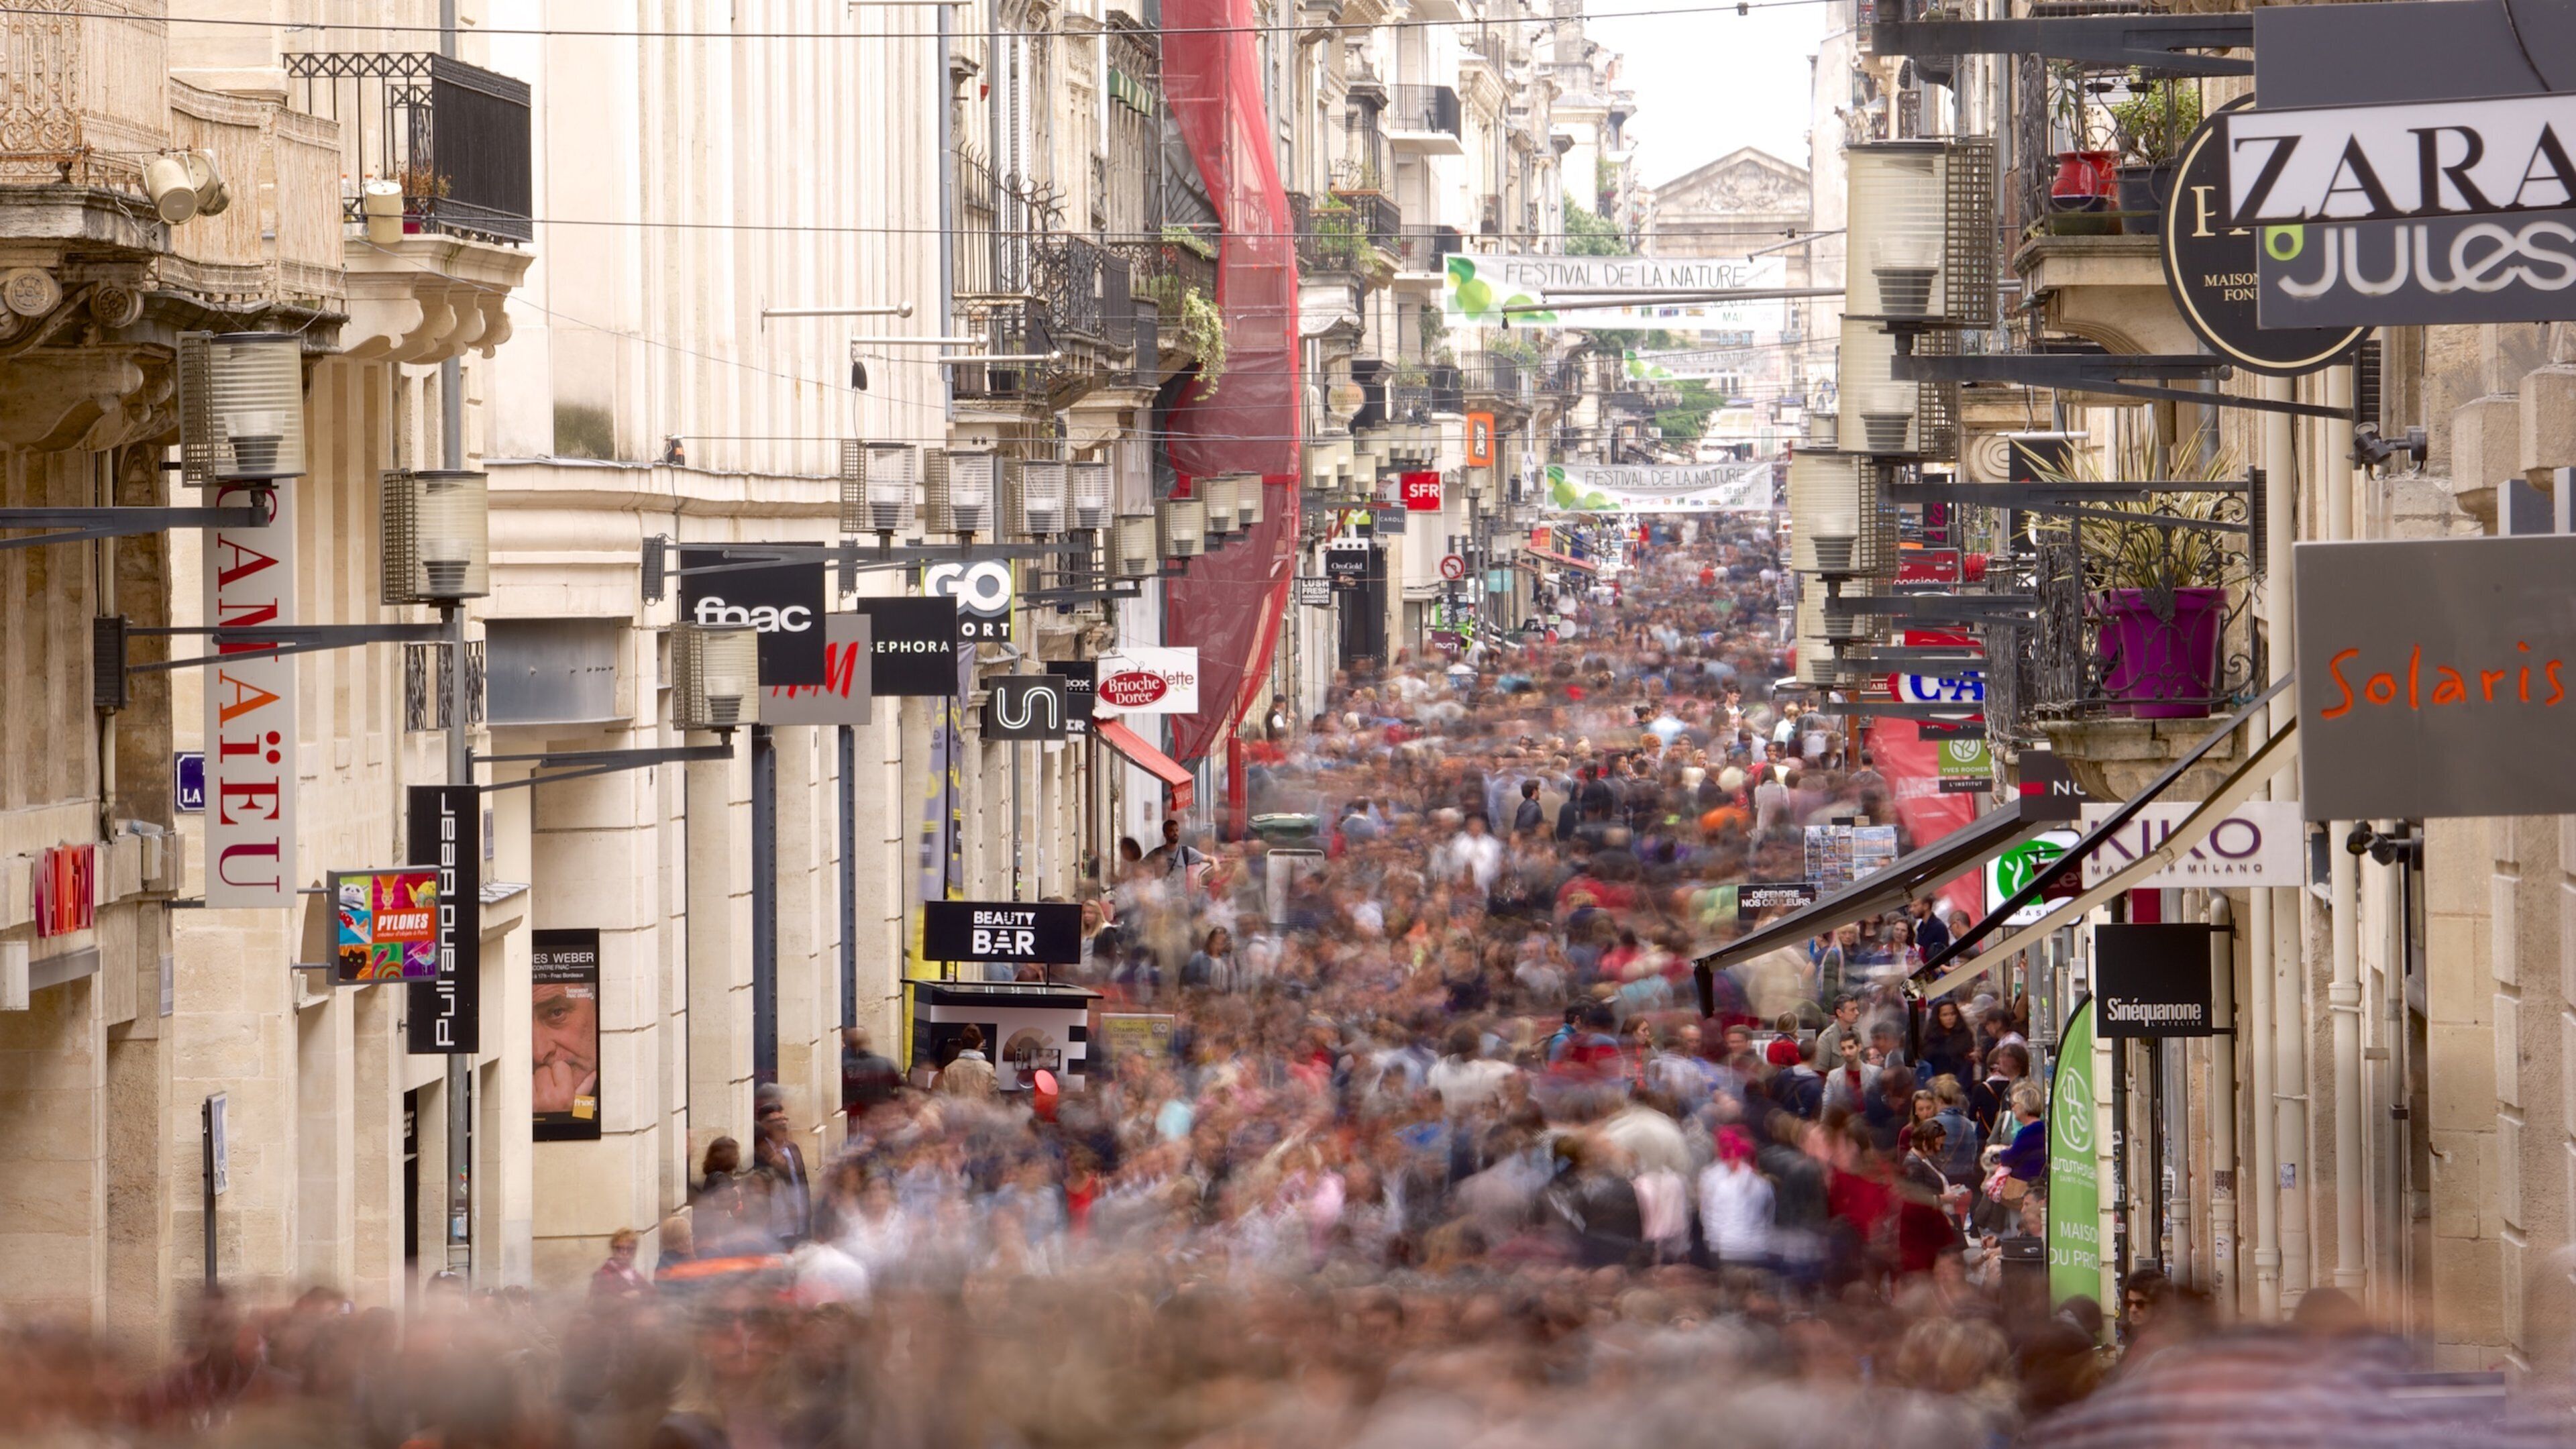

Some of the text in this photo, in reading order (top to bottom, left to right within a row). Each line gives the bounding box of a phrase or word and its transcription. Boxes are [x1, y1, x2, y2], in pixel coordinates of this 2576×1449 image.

[2235, 123, 2576, 223] ZARA
[1506, 263, 1747, 288] FESTIVAL DE LA NATURE
[2224, 288, 2258, 301] FON
[1723, 313, 1742, 322] MAI
[1585, 468, 1746, 486] FESTIVAL DE LA NATURE
[1409, 483, 1439, 498] SFR
[1723, 486, 1731, 494] 30
[1730, 497, 1744, 505] MAI
[924, 561, 1012, 612] GO
[694, 596, 812, 633] fnac
[961, 622, 1010, 637] ORT
[1108, 676, 1161, 693] Brioche
[2320, 641, 2565, 720] Solaris
[1115, 690, 1154, 704] Dorée
[182, 788, 202, 803] LA
[2188, 864, 2262, 873] MILANO
[1752, 889, 1800, 899] DÉFENDRE
[1741, 898, 1811, 908] NOS COULEURS
[377, 913, 429, 932] PYLONES
[973, 910, 1036, 925] BEAUTY
[972, 929, 1036, 955] BAR
[553, 952, 594, 963] WEBER
[435, 980, 455, 1046] Pull
[2107, 997, 2202, 1028] Sinéquanone
[1152, 1023, 1167, 1033] GO
[2060, 1221, 2098, 1244] MAISO
[2074, 1249, 2100, 1271] PRO
